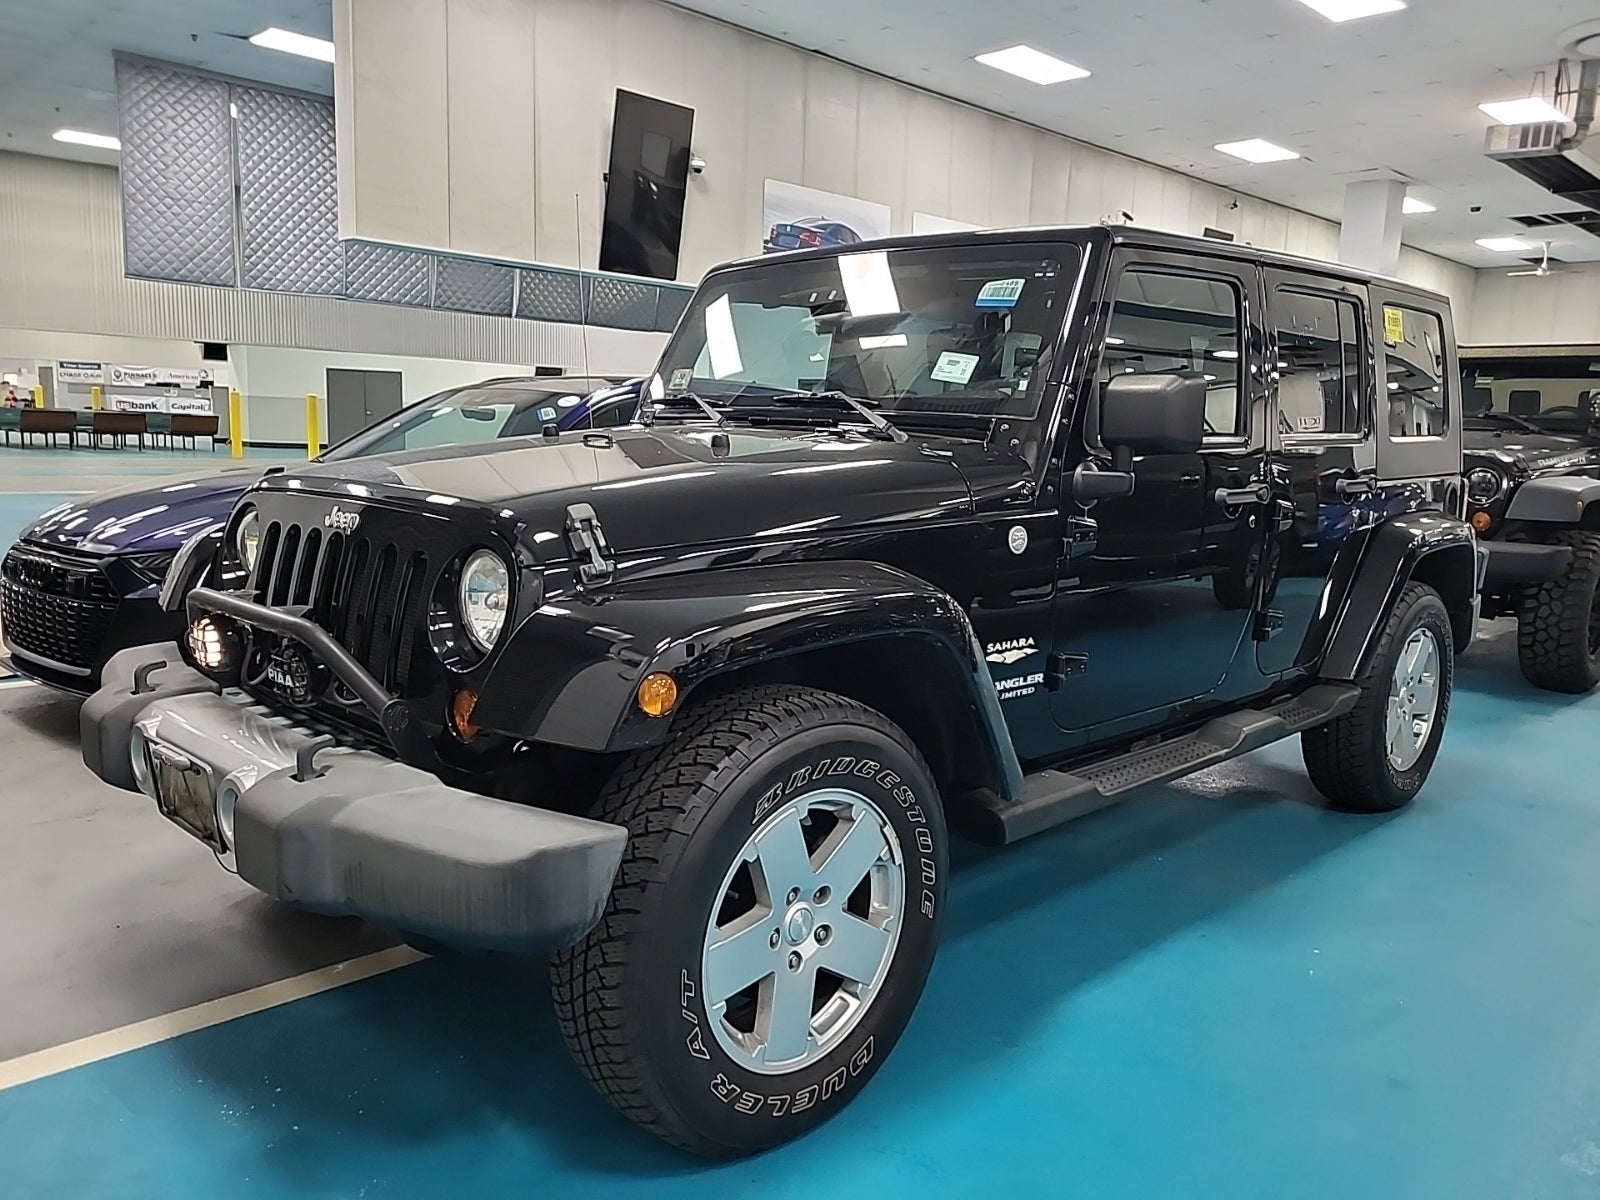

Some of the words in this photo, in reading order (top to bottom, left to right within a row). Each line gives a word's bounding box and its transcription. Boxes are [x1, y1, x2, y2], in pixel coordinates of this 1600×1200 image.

[324, 505, 360, 536] Jeep
[986, 636, 1035, 653] SAHARA
[267, 667, 295, 688] PIAA
[752, 756, 936, 919] BRIDGESTONE
[710, 1035, 874, 1117] DUELER
